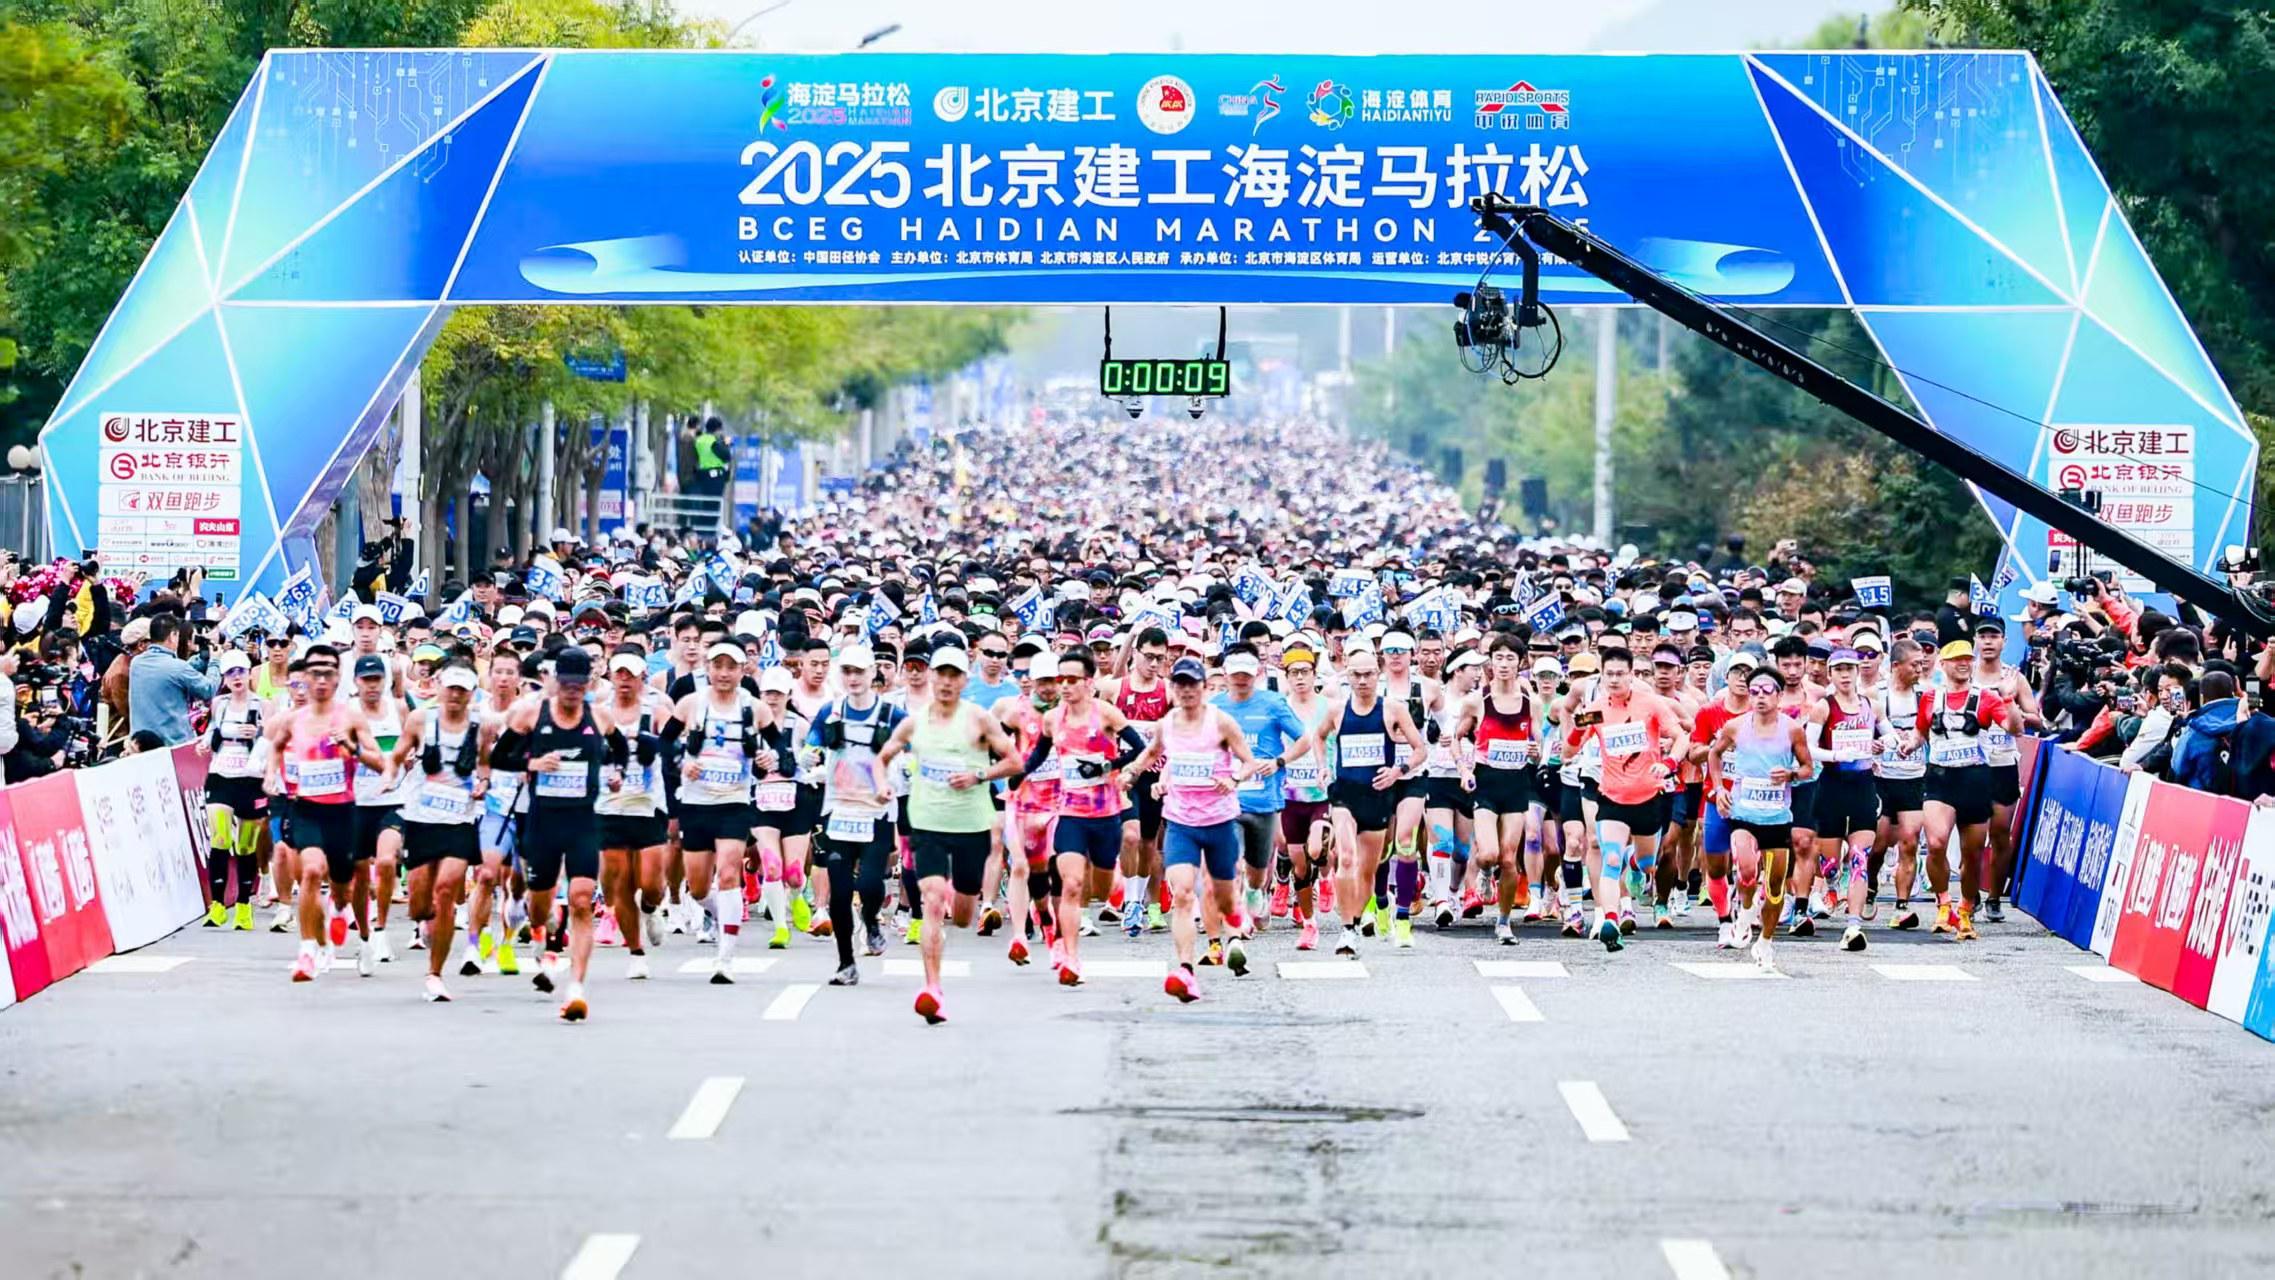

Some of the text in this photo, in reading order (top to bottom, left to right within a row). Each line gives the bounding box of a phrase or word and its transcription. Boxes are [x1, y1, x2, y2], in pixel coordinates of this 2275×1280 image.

[788, 83, 910, 106] 海淀马拉松
[1363, 90, 1451, 108] 海淀体育
[975, 88, 1115, 122] 北京建工
[787, 108, 847, 125] 2025
[1362, 110, 1451, 121] HAIDIANTIYU
[739, 217, 862, 240] BCEG
[901, 217, 1117, 241] HAIDIAN
[1157, 218, 1435, 242] MARATHON
[804, 251, 880, 264] 中国田径协会
[956, 251, 1033, 264] 北京市体育局
[1041, 251, 1169, 264] 北京市海淀区人民政府
[1245, 252, 1361, 264] 北京市海淀区体育局
[1104, 363, 1226, 392] 0:00:09
[135, 419, 236, 443] 北京建工
[2085, 429, 2189, 455] 北京建工
[141, 452, 230, 469] 北京银行
[2091, 463, 2183, 481] 北京银行
[146, 491, 220, 511] 双鱼跑步
[2100, 503, 2173, 523] 双鱼跑步
[1750, 790, 1784, 801] A0713
